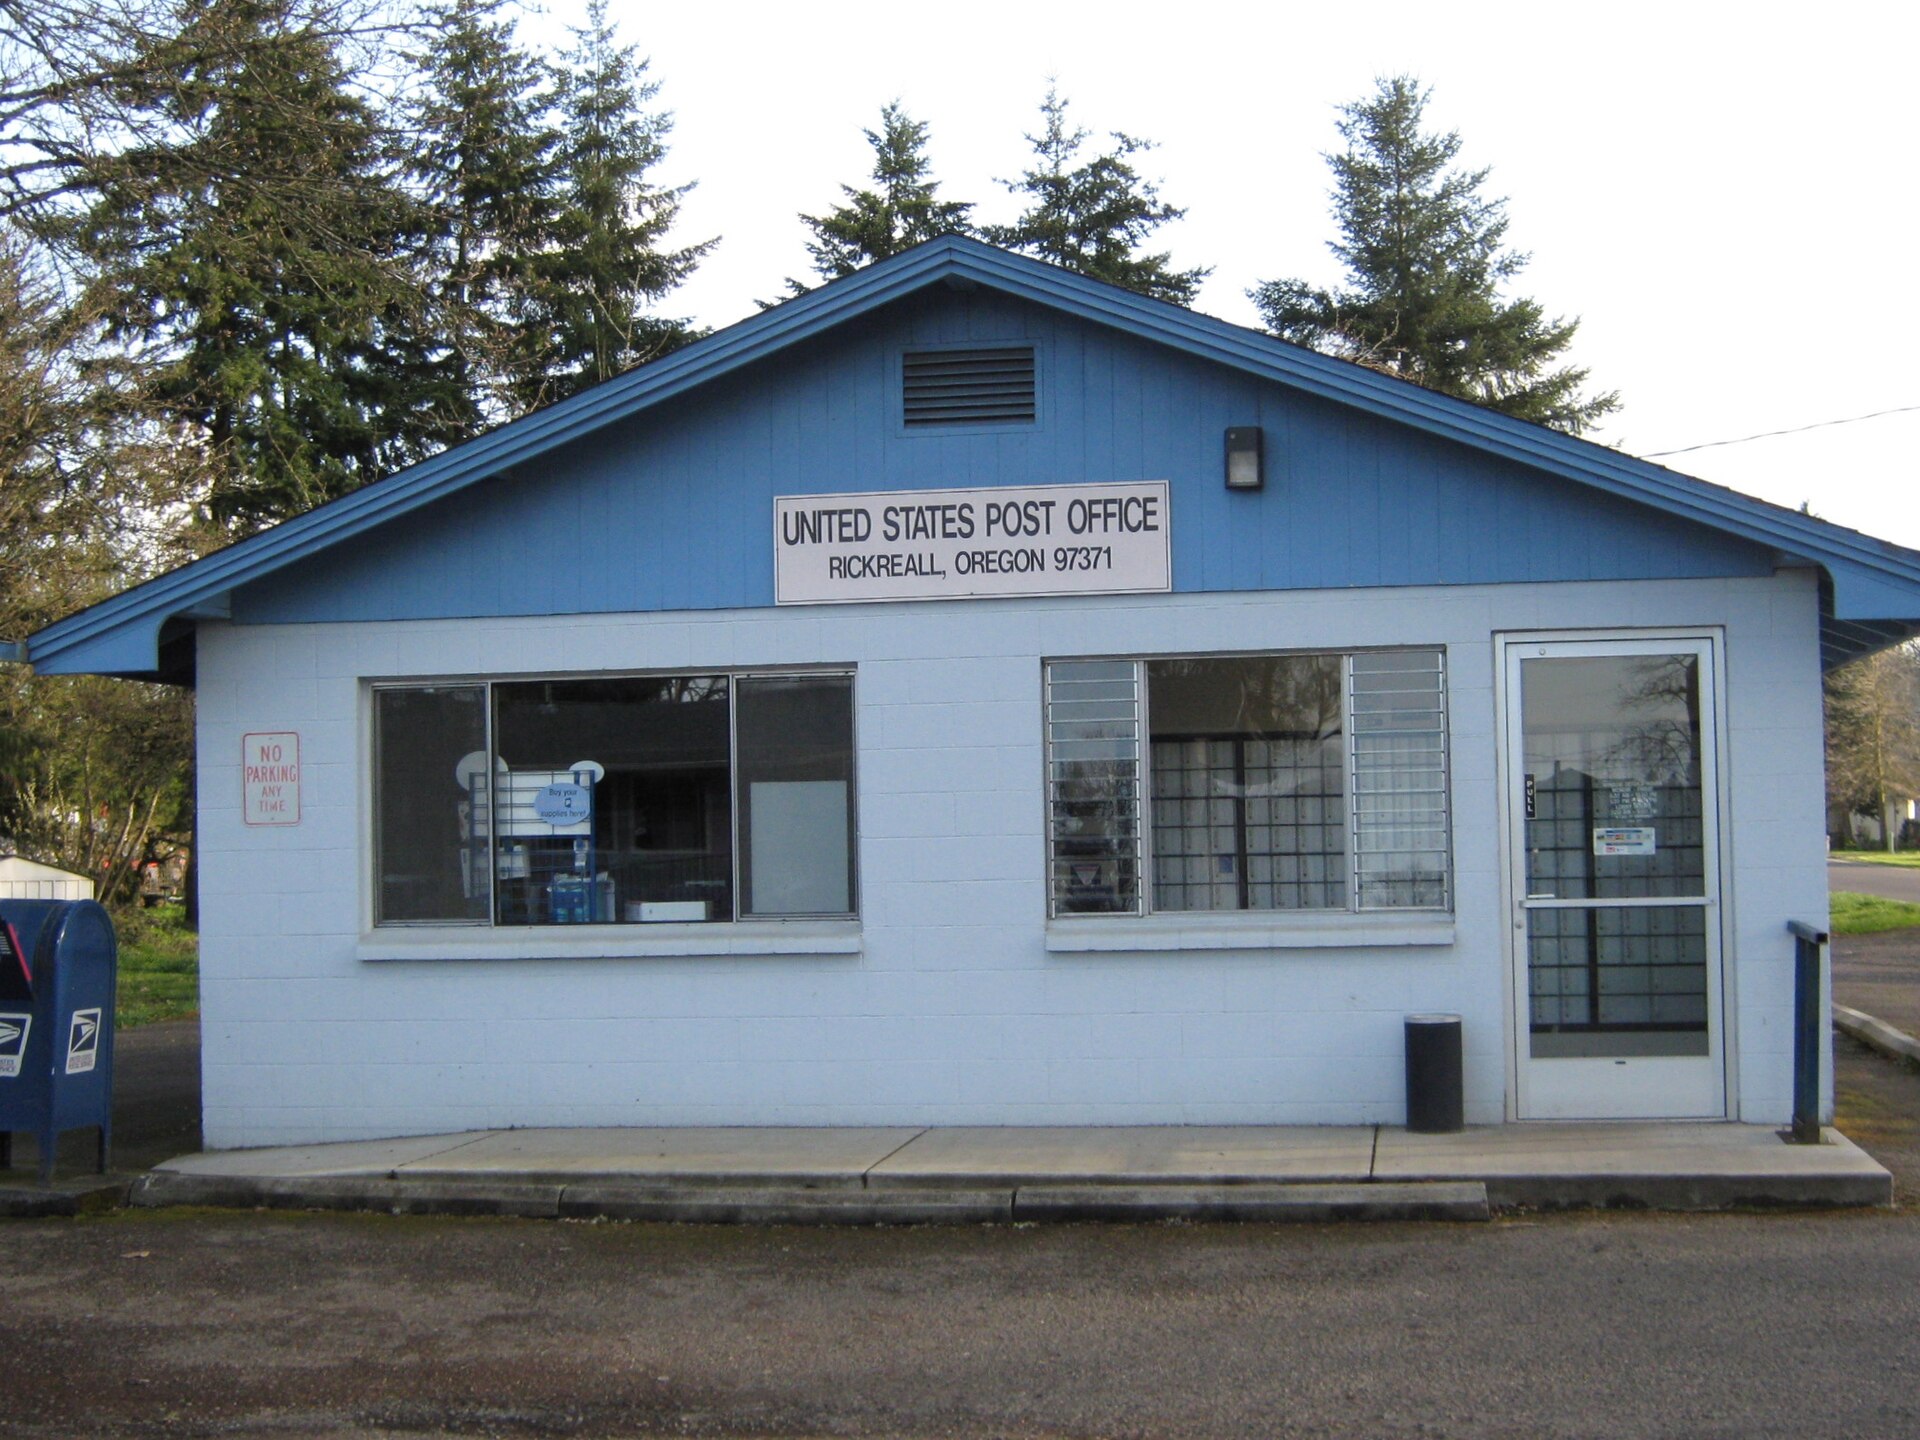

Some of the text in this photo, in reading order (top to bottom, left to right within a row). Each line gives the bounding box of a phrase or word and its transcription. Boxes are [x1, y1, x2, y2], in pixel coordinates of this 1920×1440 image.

[782, 496, 1159, 546] UNITED STATES POST OFFICE
[828, 546, 1113, 580] RICKREALL, OREGON 97371
[260, 744, 282, 762] NO
[246, 765, 297, 783] PARKING
[261, 785, 282, 798] ANY
[1526, 780, 1534, 812] PULL
[259, 800, 286, 813] TIME
